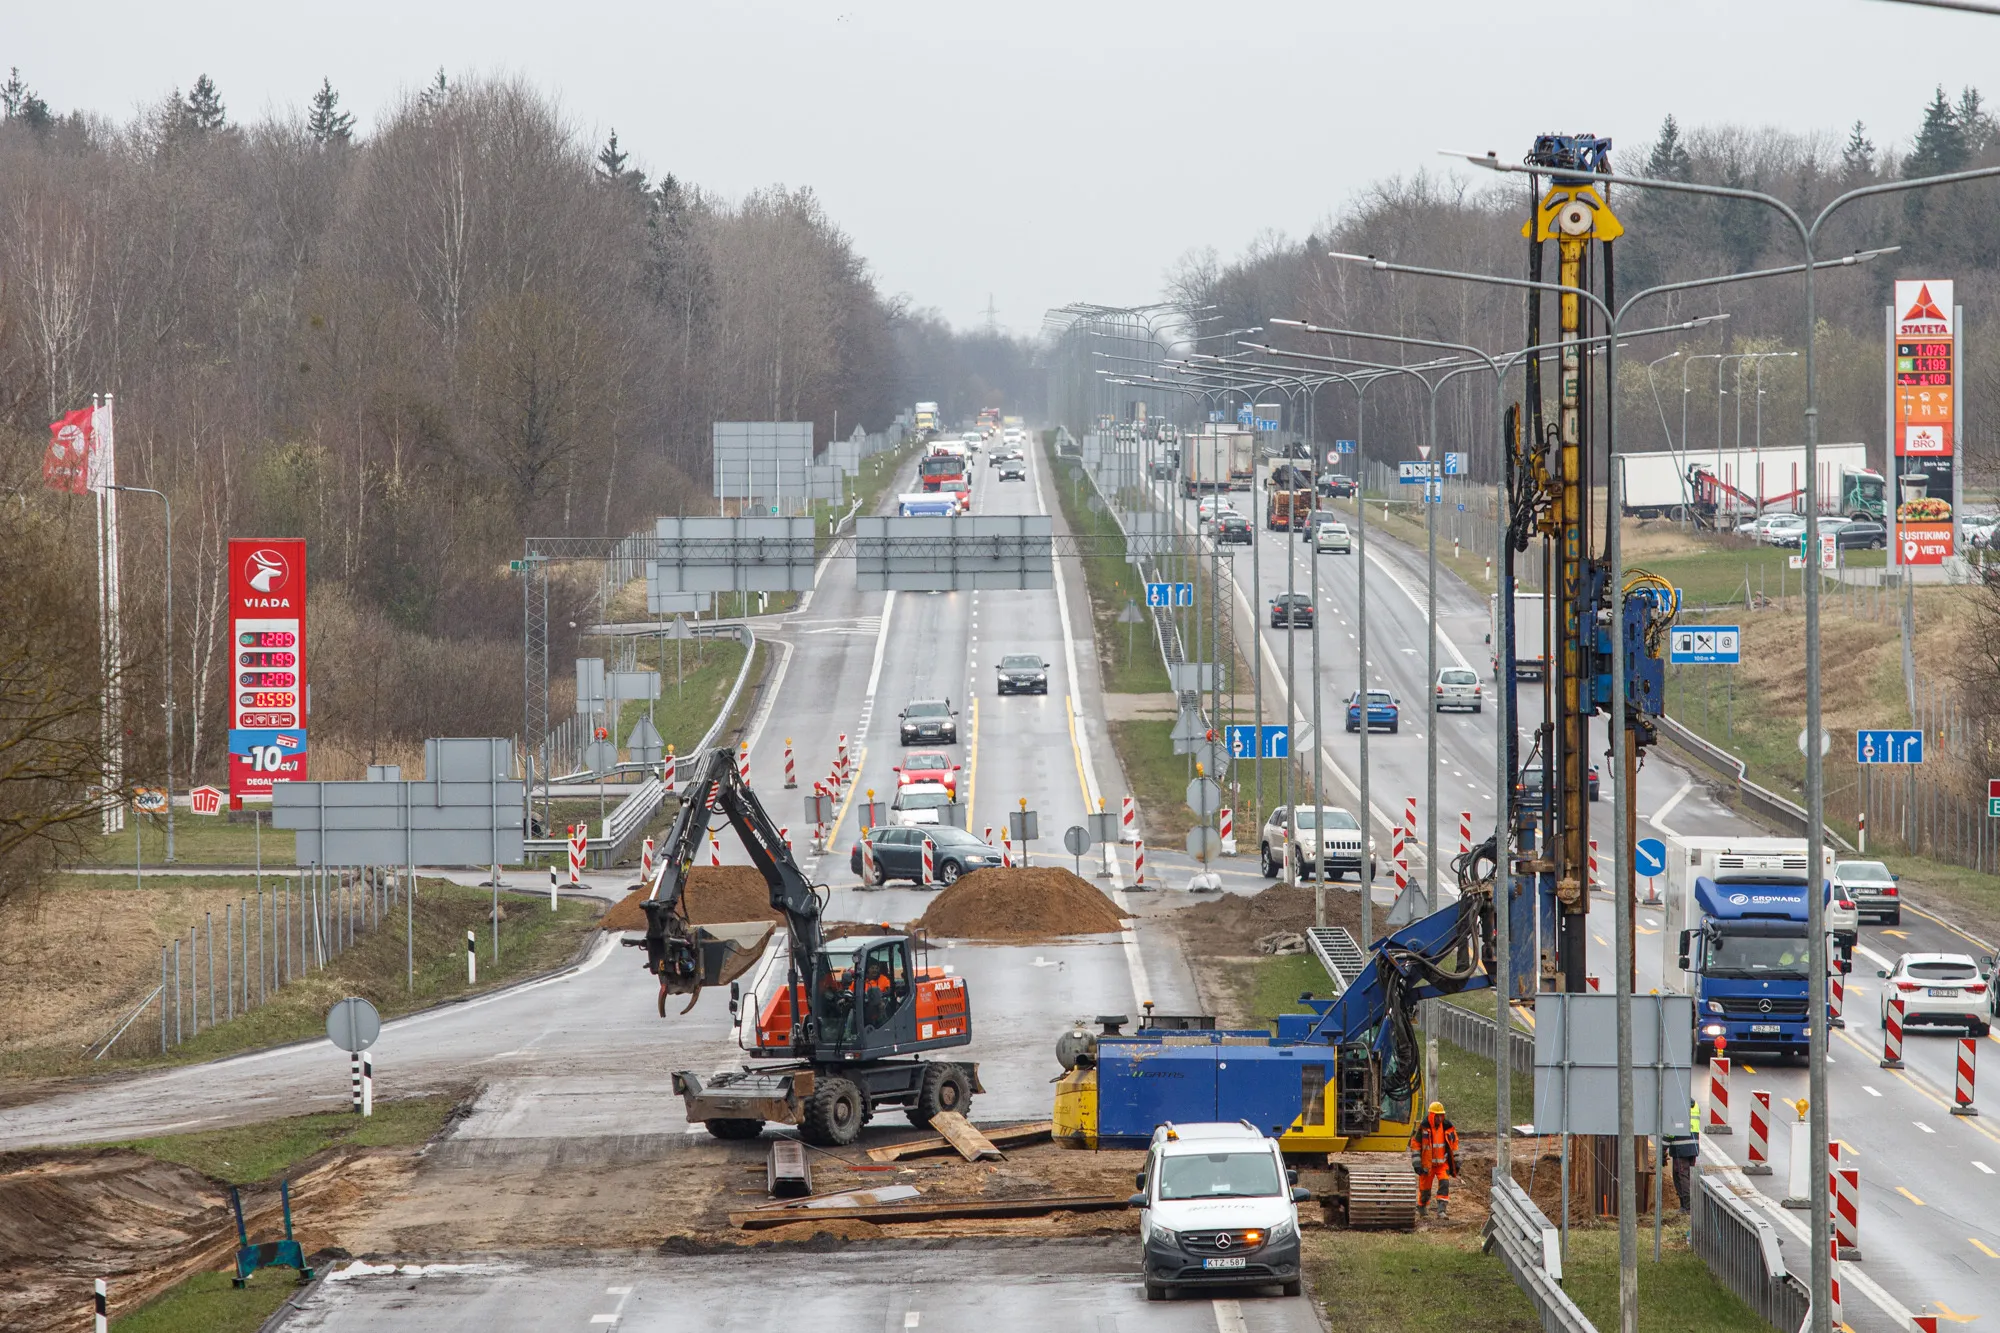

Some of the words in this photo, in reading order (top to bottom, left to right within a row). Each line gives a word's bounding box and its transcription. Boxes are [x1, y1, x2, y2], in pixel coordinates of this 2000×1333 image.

[1901, 325, 1947, 334] STATETA
[1901, 346, 1909, 354] D
[1916, 344, 1947, 356] 1.079
[1916, 358, 1947, 371] 1.199
[1912, 440, 1936, 448] BRO
[1899, 531, 1951, 540] SUSITIKIMO
[1920, 545, 1946, 555] VIETA
[244, 598, 290, 608] VIADA
[261, 632, 294, 647] 1.289
[261, 653, 294, 667] 1.199
[261, 672, 294, 687] 1.209
[256, 692, 294, 707] 0.599
[240, 746, 282, 772] -10
[193, 788, 219, 812] UTA
[1752, 895, 1801, 903] GROWARD
[935, 982, 951, 991] ATLAS
[1207, 1259, 1225, 1267] KTZ
[1230, 1258, 1245, 1266] 587
